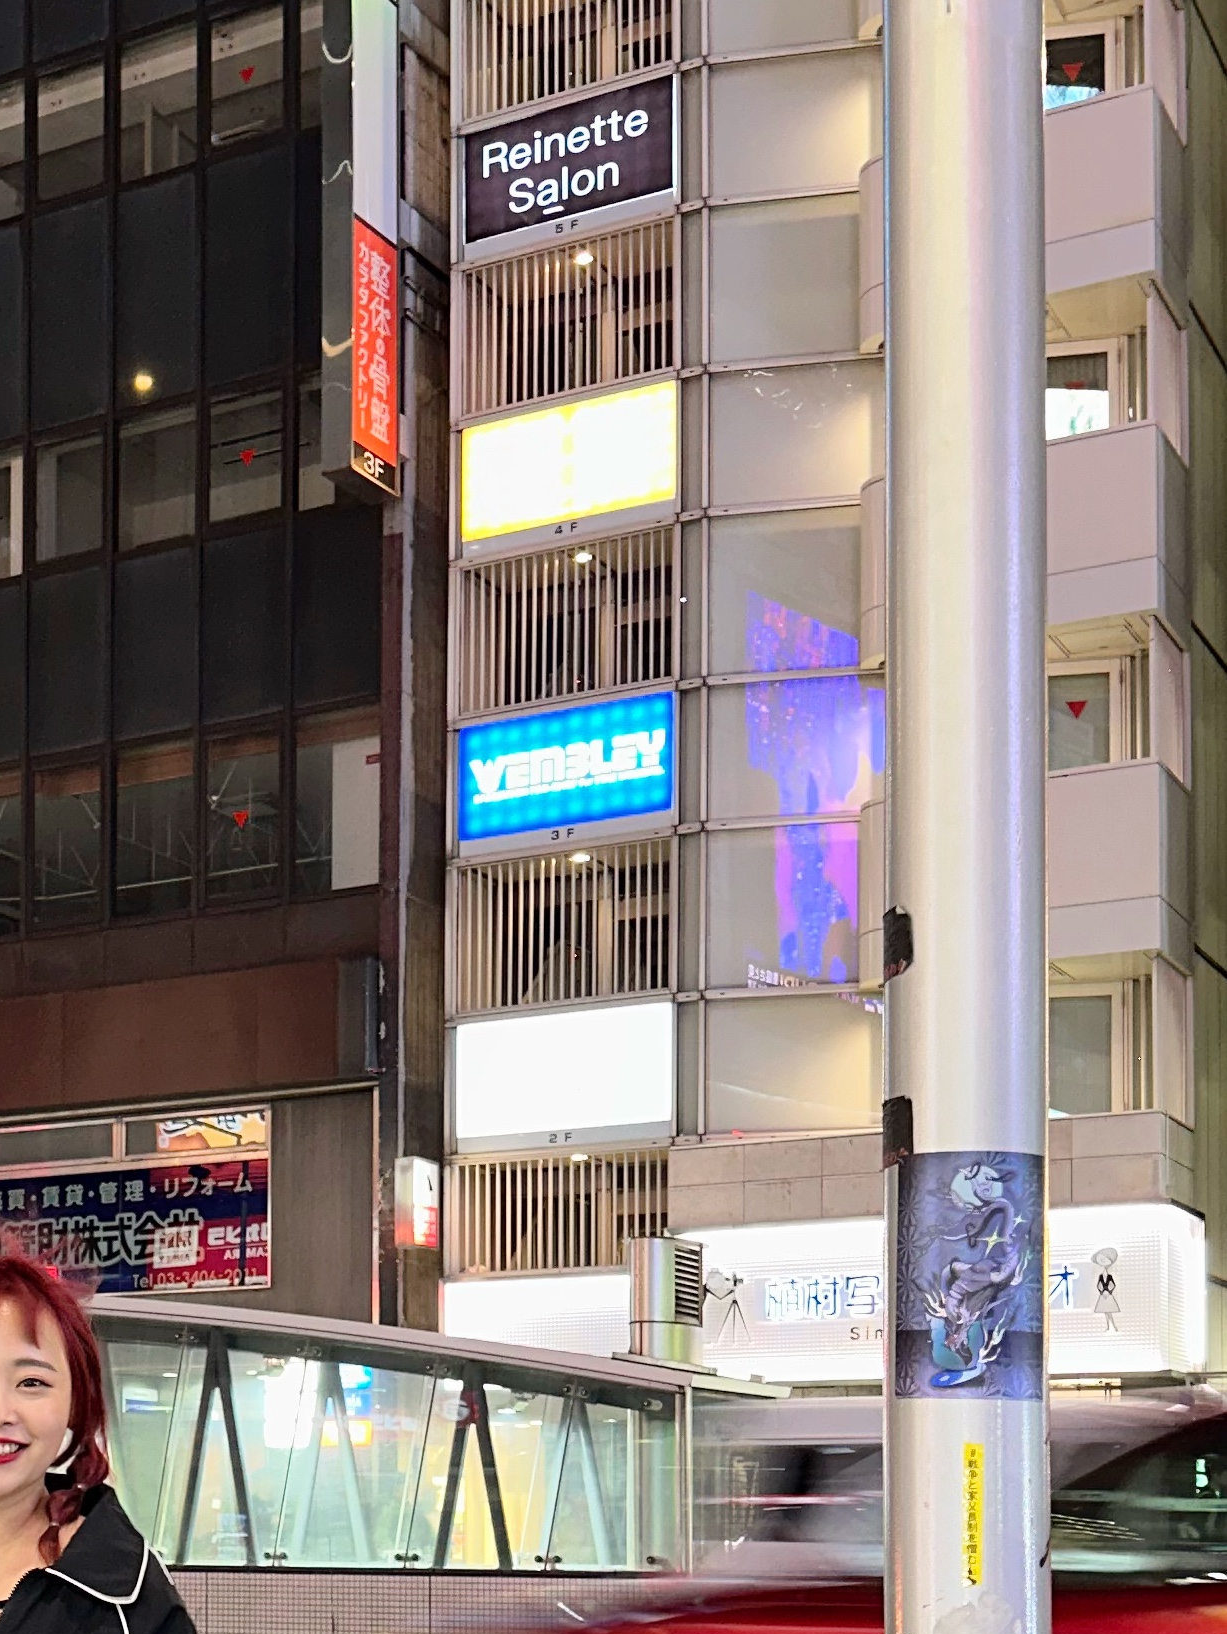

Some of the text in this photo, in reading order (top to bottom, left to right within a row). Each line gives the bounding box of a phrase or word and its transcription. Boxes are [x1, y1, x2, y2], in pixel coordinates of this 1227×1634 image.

[482, 109, 649, 178] Reinette
[508, 162, 620, 214] Salon
[358, 241, 370, 430] カラダファクトリー
[362, 450, 385, 479] 3F
[469, 728, 666, 794] WEMBLEY
